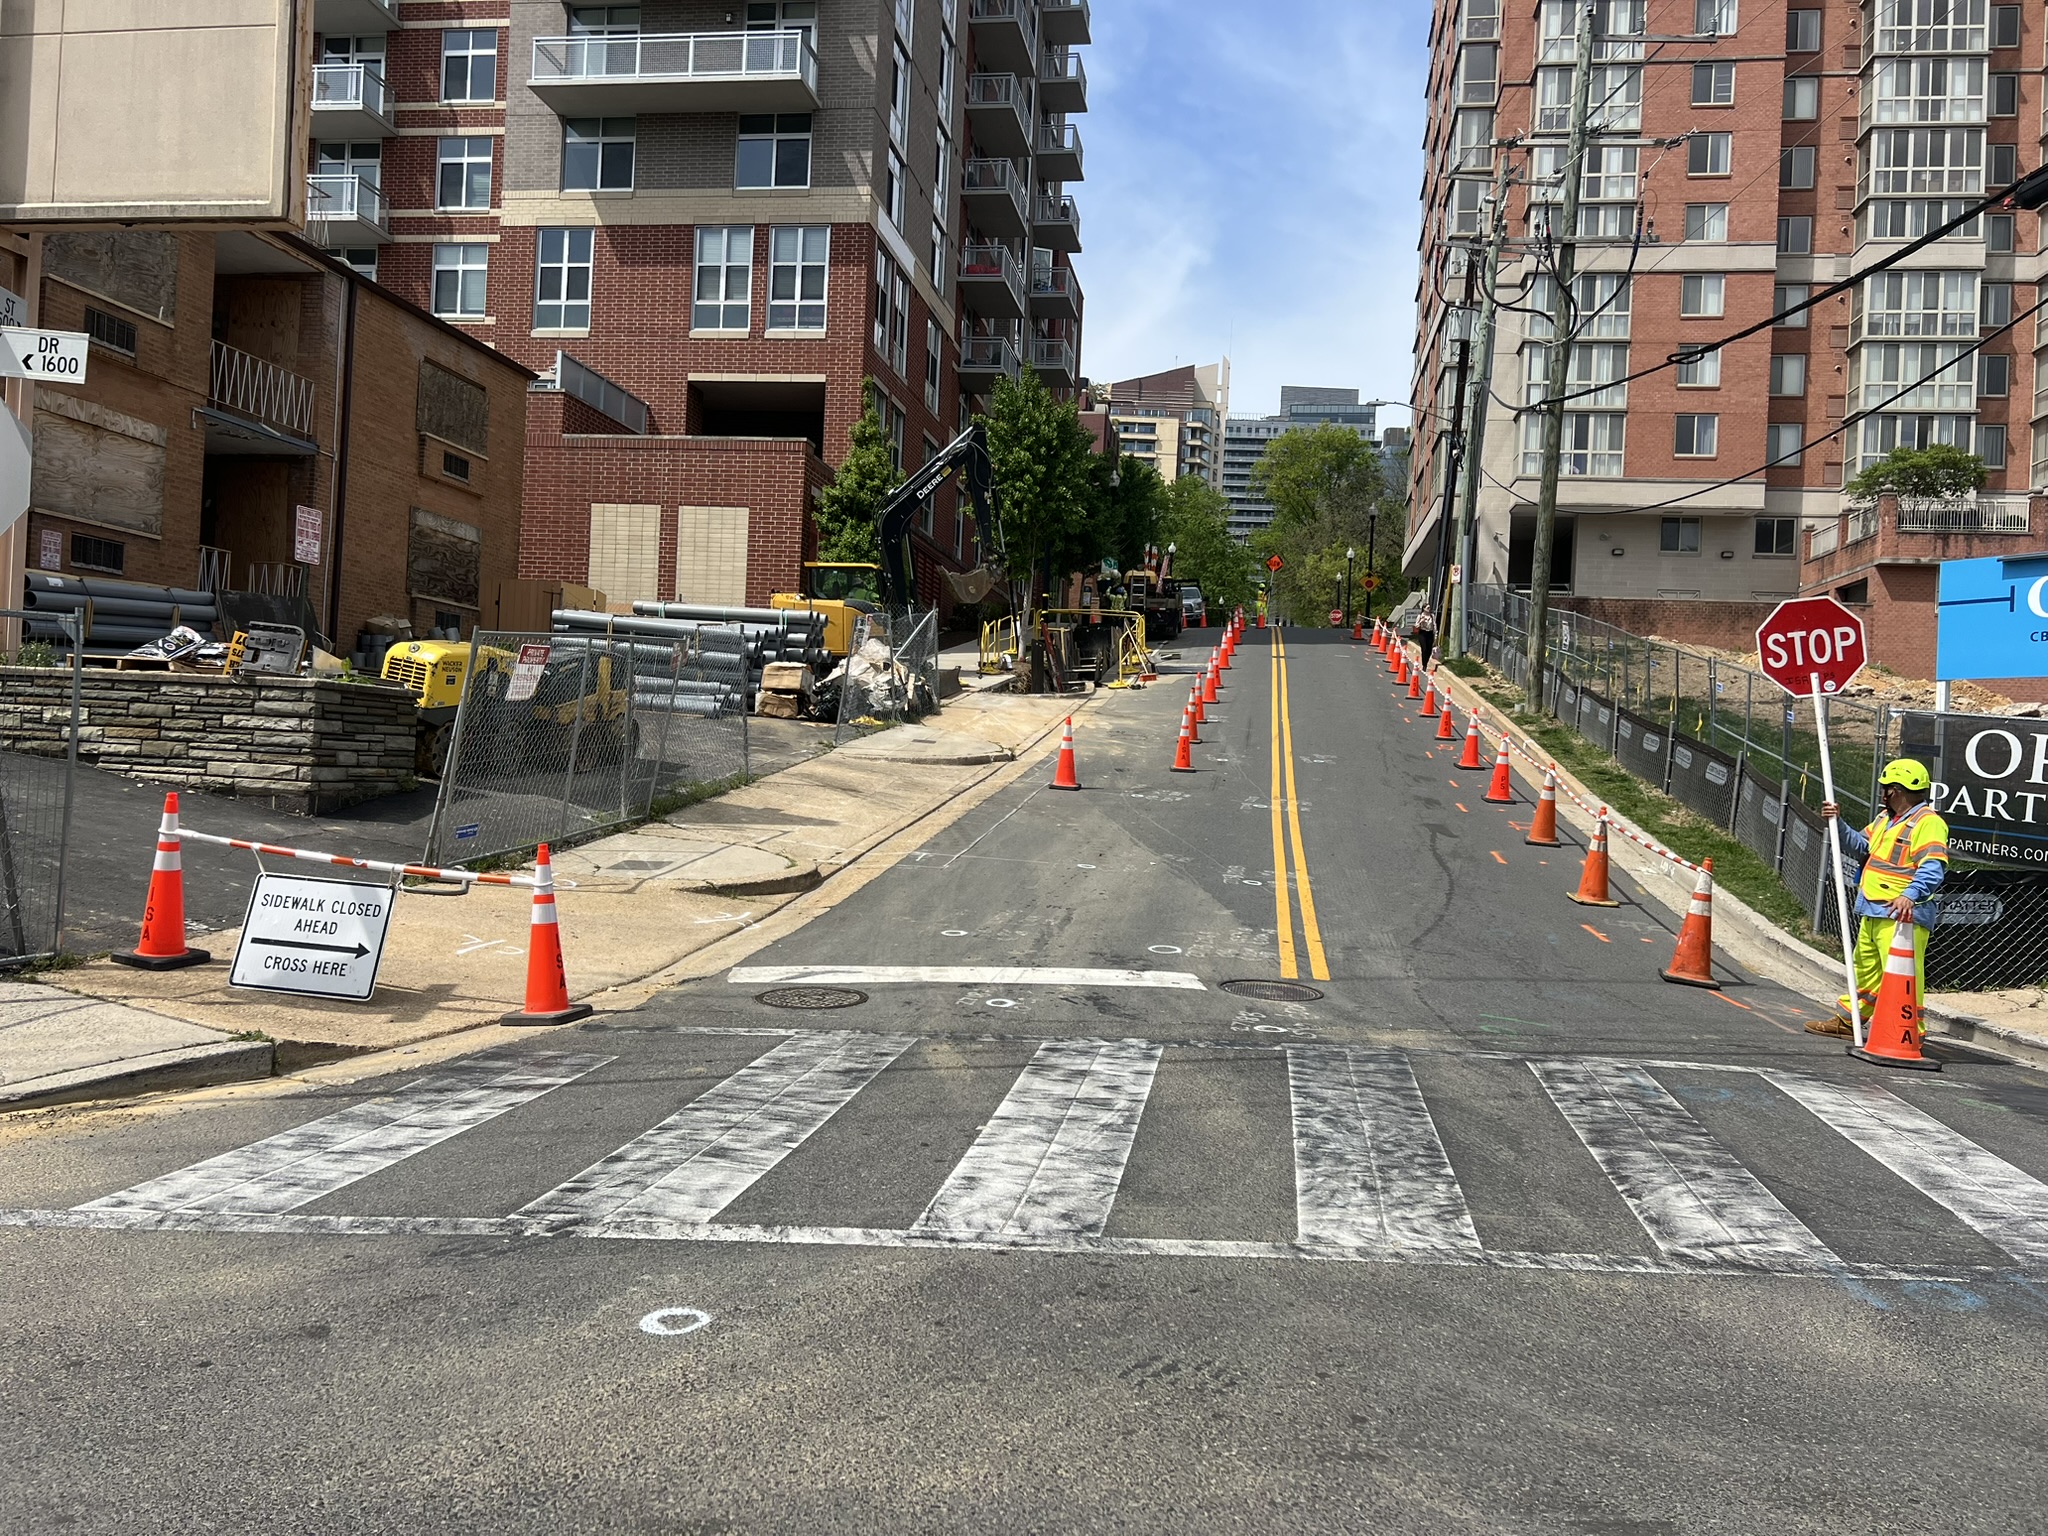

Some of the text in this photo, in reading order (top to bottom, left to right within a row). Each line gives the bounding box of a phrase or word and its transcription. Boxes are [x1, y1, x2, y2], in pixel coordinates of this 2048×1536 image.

[5, 298, 16, 316] ST
[38, 336, 60, 354] DR
[42, 355, 79, 374] 1600
[916, 473, 944, 500] DEERE
[1766, 626, 1857, 669] STOP
[1929, 781, 2048, 824] PART
[261, 893, 382, 918] SIDEWALK CLOSED
[293, 918, 338, 935] AHEAD
[264, 955, 348, 977] CROSS HERE
